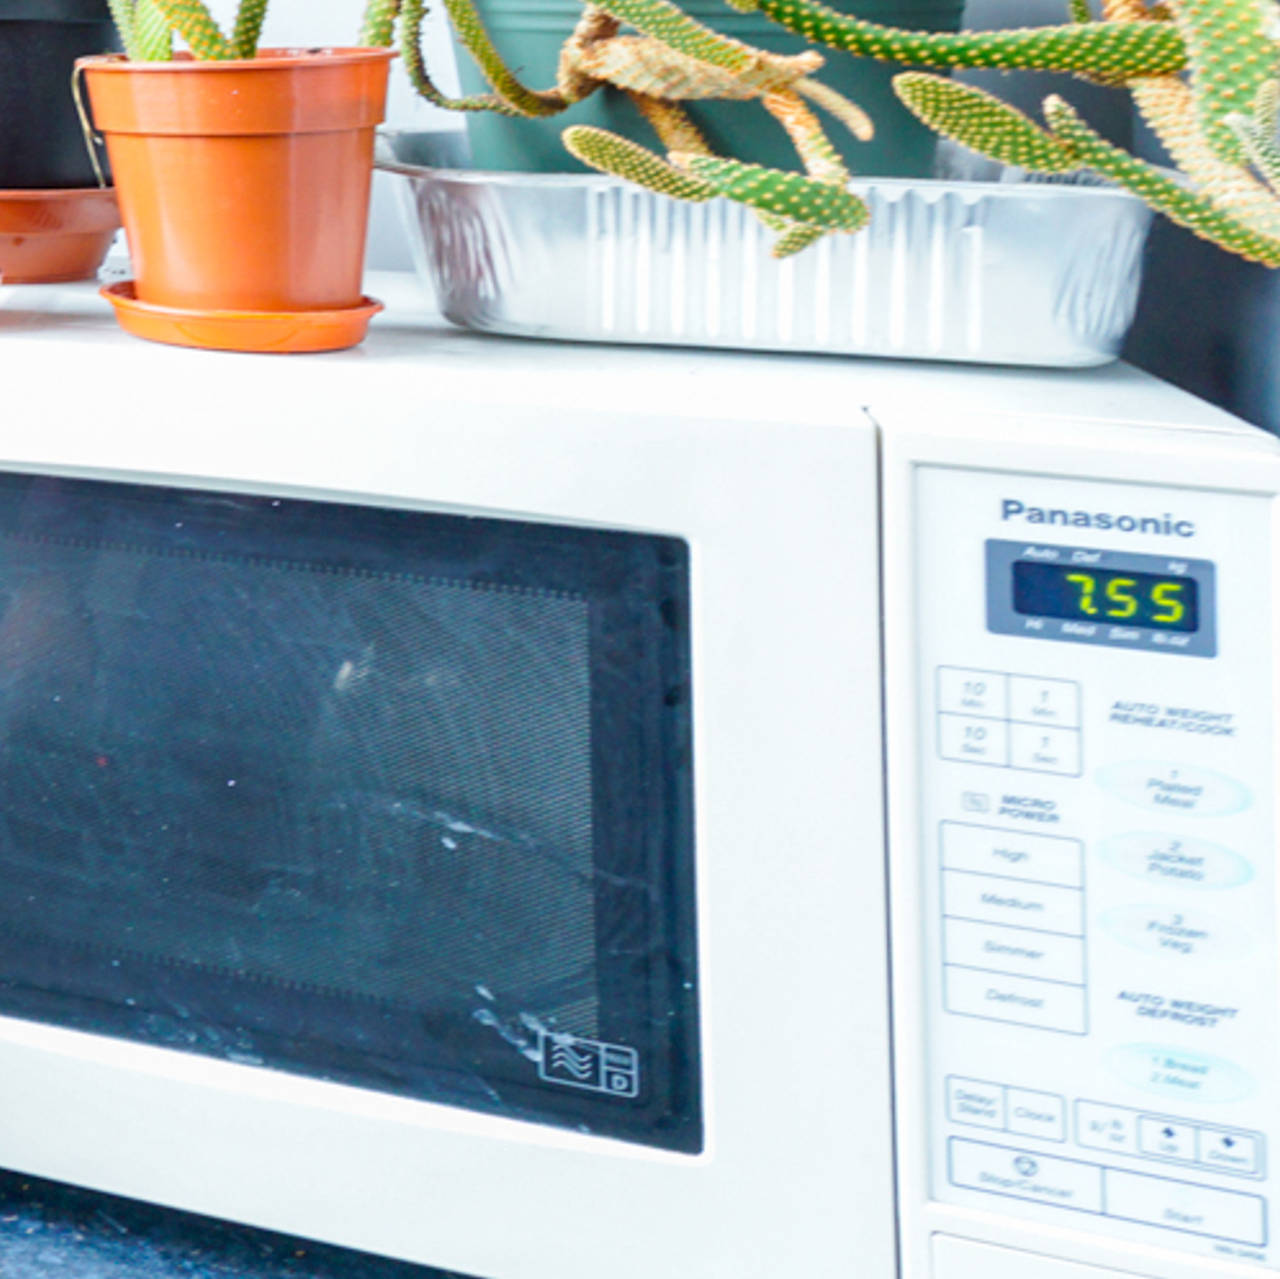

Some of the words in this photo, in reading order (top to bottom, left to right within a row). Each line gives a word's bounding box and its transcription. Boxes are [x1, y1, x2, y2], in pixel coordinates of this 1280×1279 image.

[1001, 499, 1196, 538] Panasonic
[1022, 546, 1059, 560] Auto
[963, 682, 986, 696] 10
[1111, 700, 1160, 717] AUTO
[1165, 707, 1235, 724] WEIGHT
[964, 727, 986, 741] 10
[1001, 794, 1056, 811] MICRO
[997, 806, 1060, 823] POWER
[1117, 991, 1165, 1006] AUTO
[1169, 999, 1240, 1018] WEIGHT
